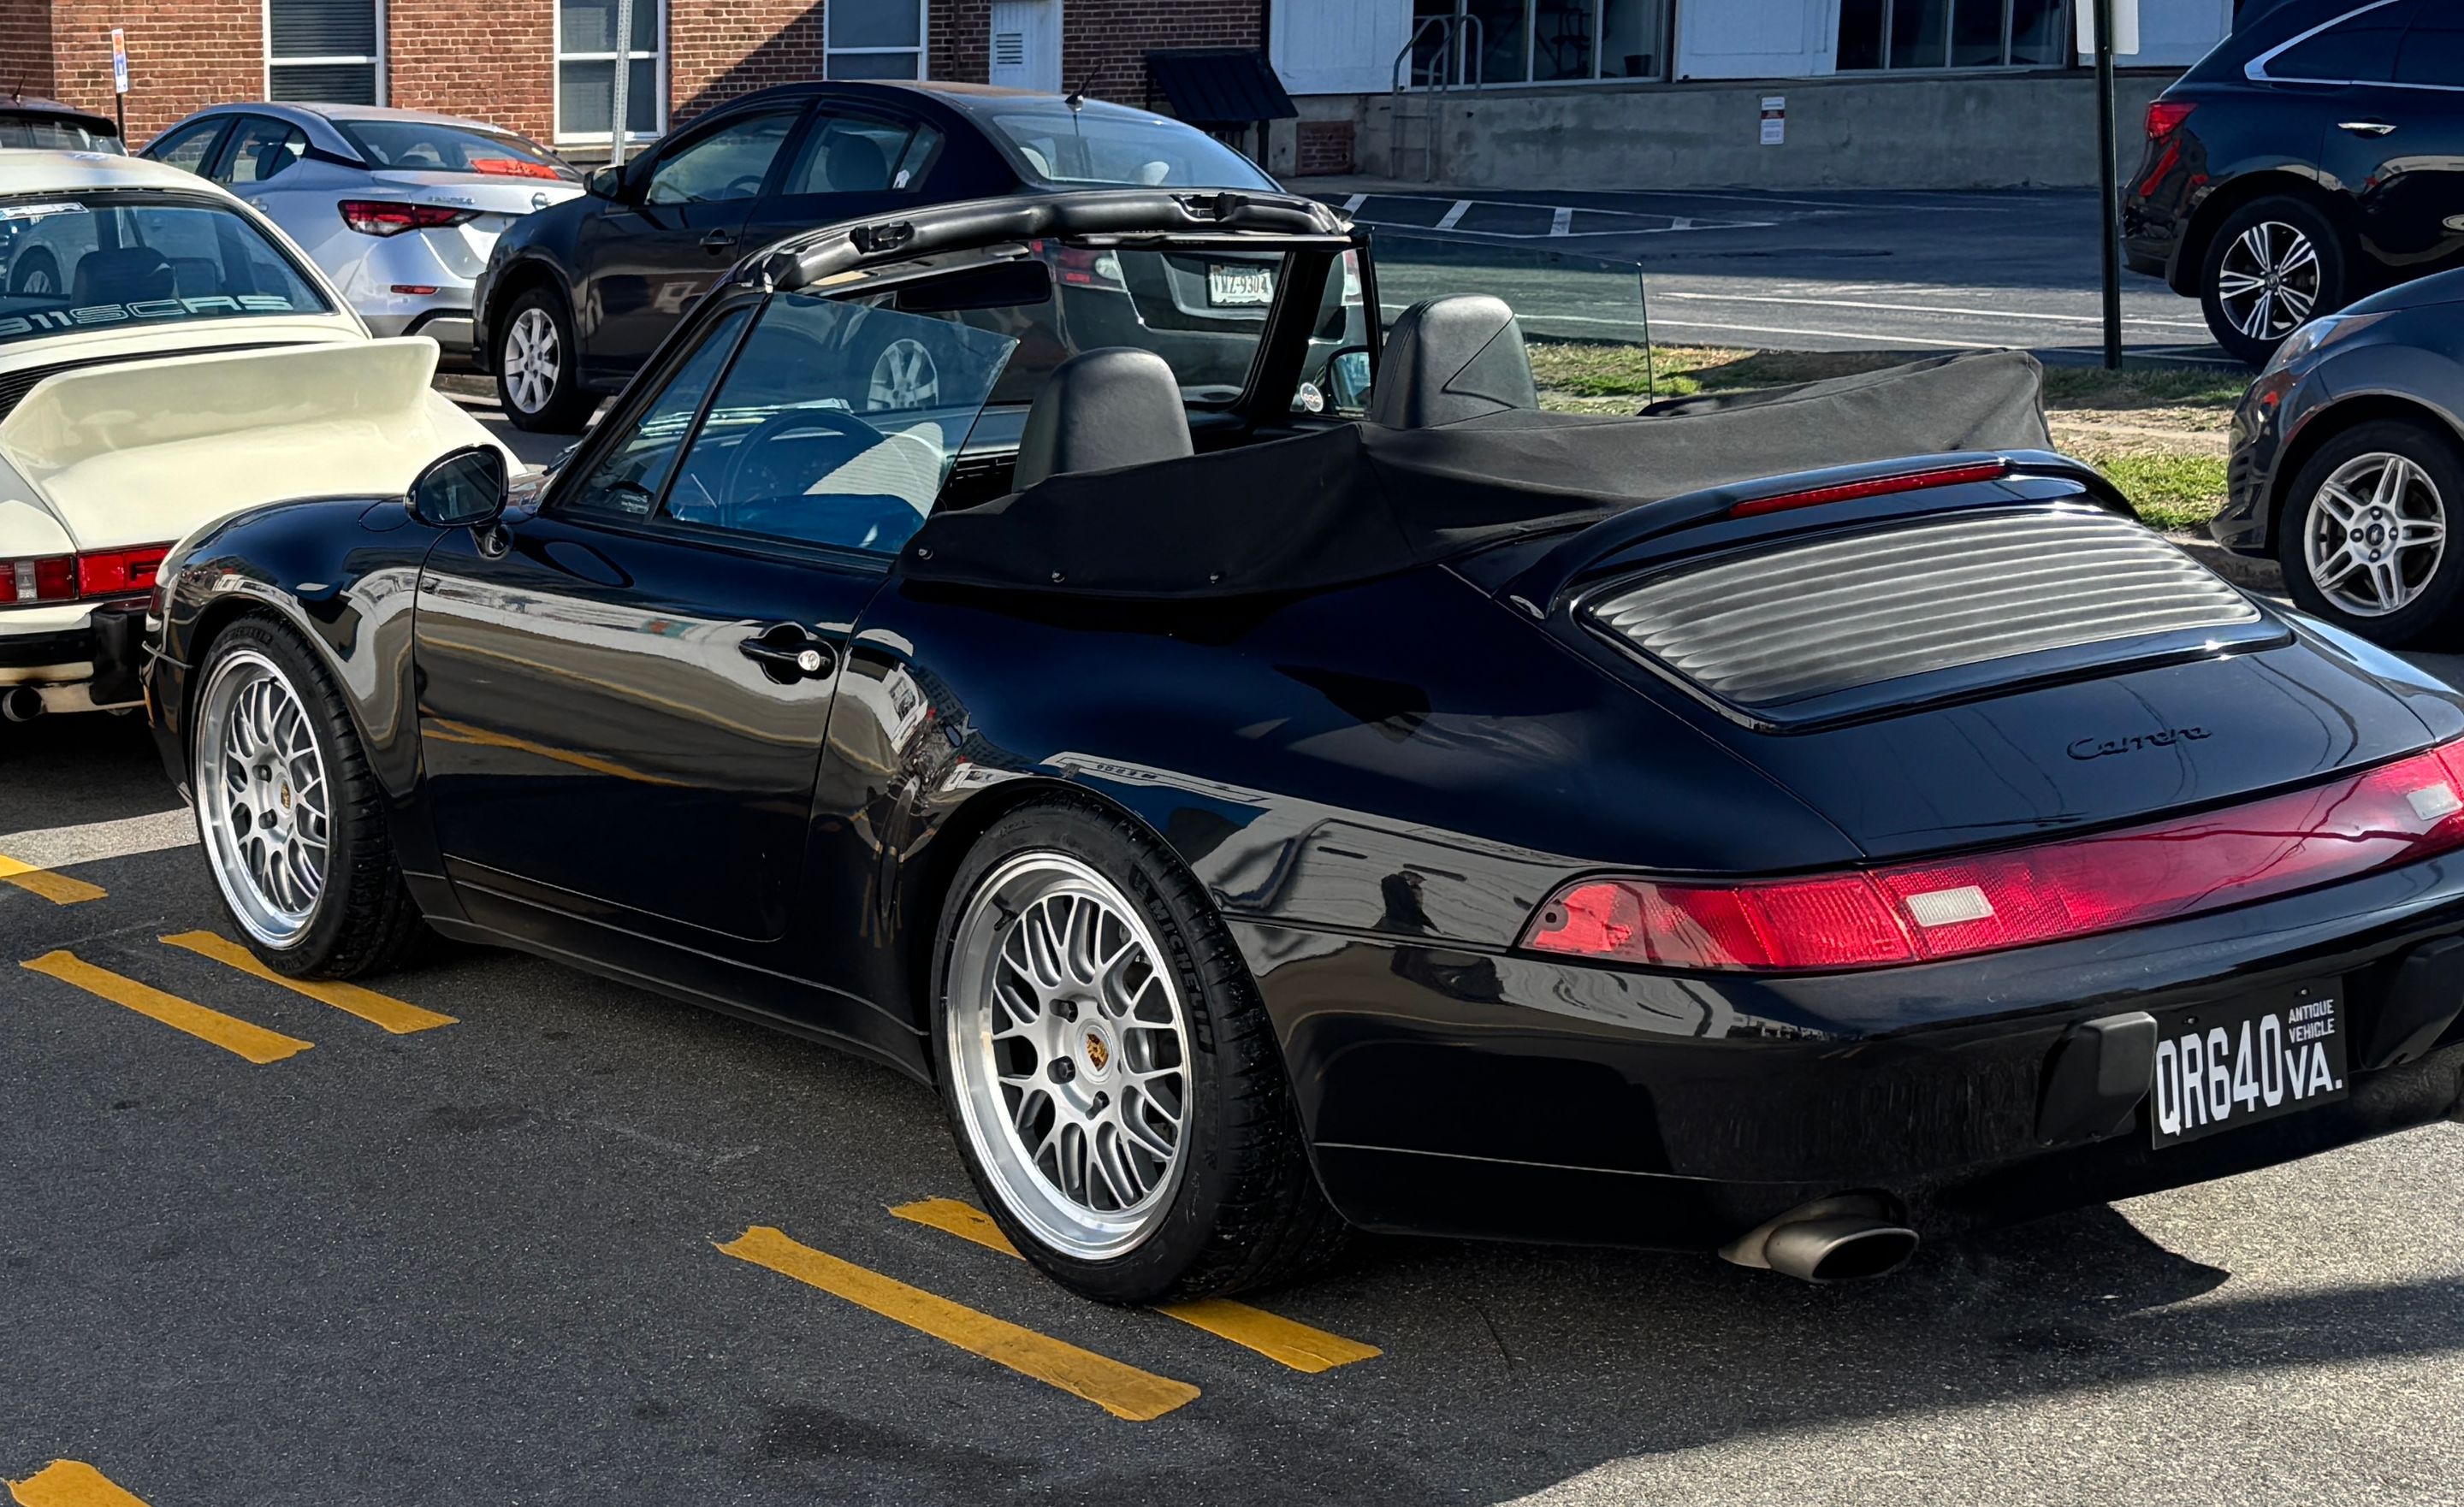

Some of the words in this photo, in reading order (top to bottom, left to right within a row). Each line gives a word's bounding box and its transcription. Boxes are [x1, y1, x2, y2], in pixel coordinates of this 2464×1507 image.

[2066, 727, 2213, 760] Carrera
[1149, 898, 1214, 1046] MICHELIN
[2288, 999, 2335, 1025] ANTIQUE
[2288, 1018, 2336, 1043] VEHICLE
[2155, 1013, 2284, 1137] QR640
[2284, 1041, 2343, 1101] VA.
